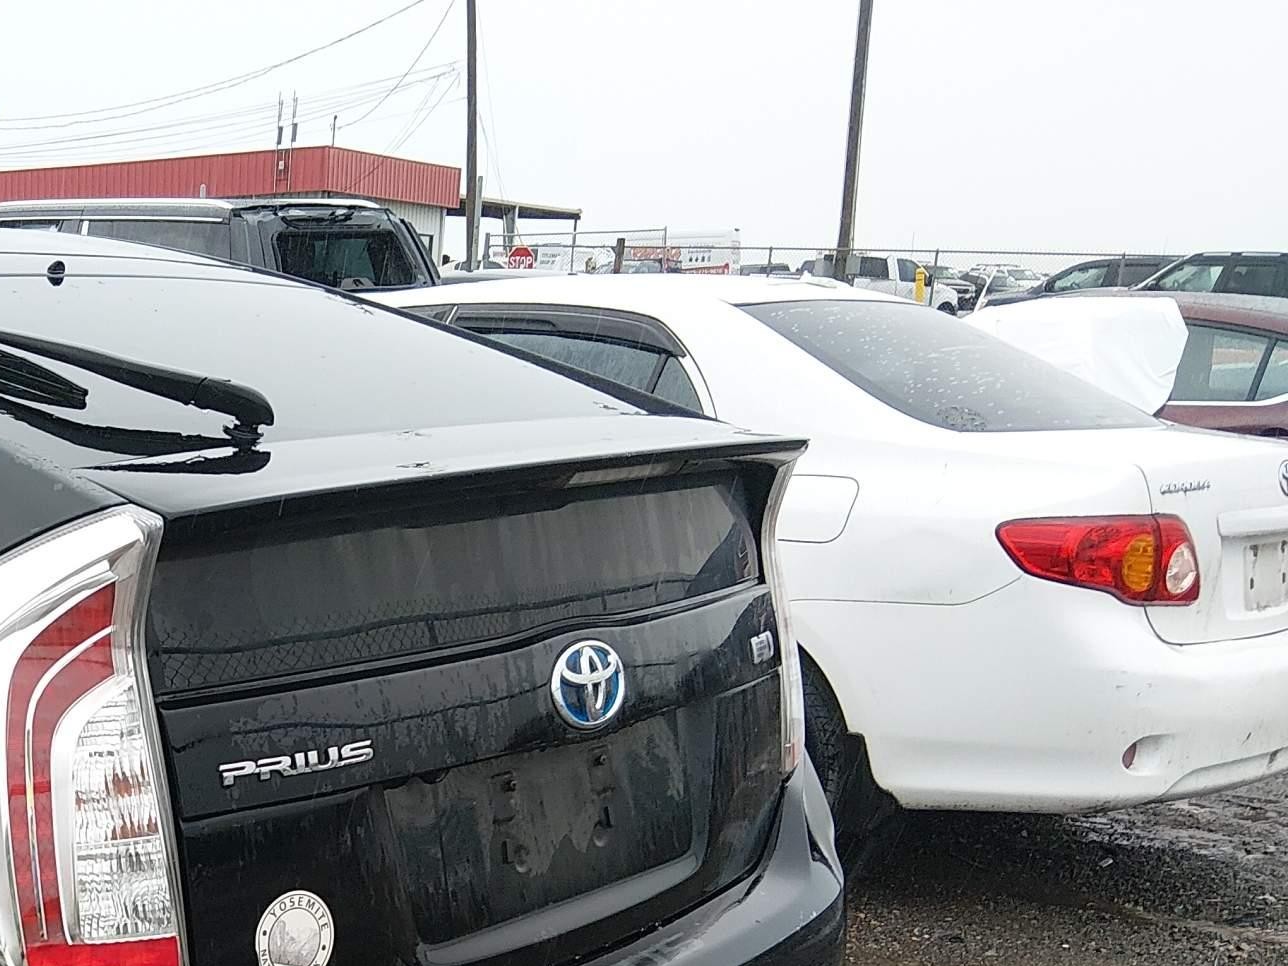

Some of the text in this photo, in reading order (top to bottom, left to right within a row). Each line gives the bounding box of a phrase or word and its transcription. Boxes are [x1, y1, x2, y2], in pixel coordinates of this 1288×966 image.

[509, 255, 533, 269] STOP
[219, 739, 374, 786] PRIUS
[269, 896, 329, 932] YOSEMITE
